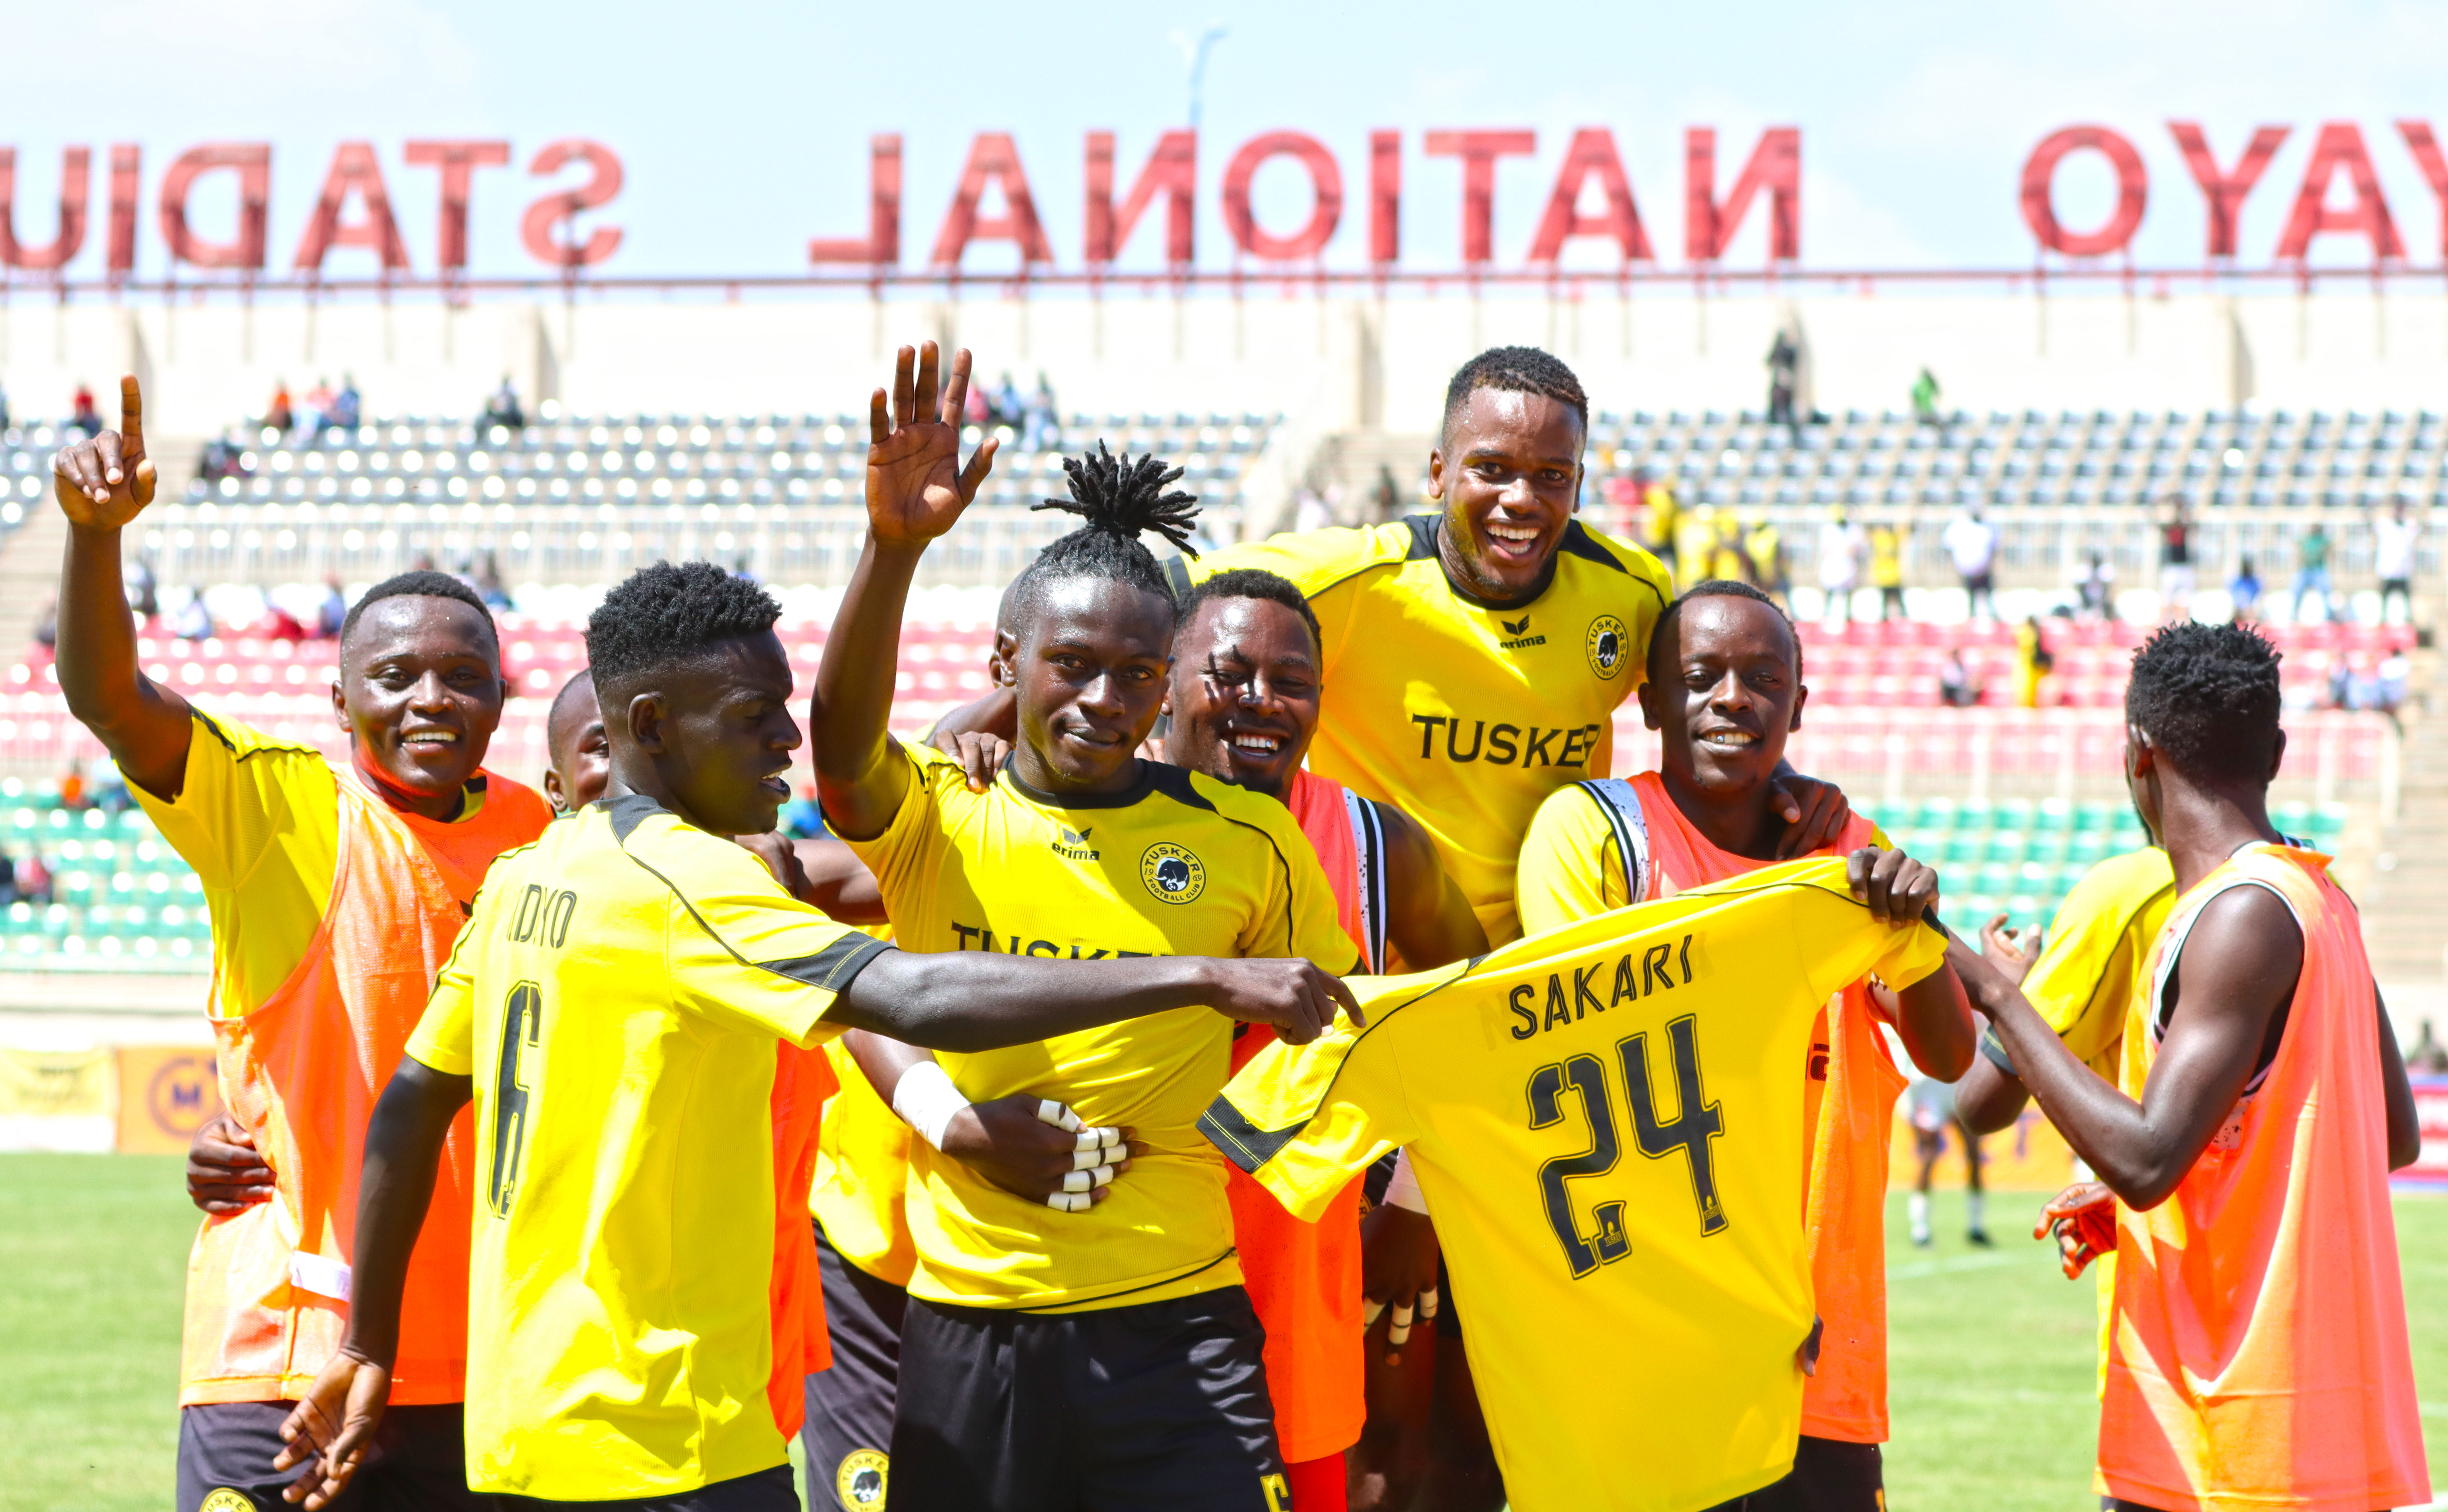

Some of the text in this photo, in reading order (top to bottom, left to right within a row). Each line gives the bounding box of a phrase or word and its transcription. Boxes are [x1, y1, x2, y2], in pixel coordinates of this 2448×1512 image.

[1500, 635, 1546, 649] erima
[1589, 620, 1625, 647] TUSKER
[1592, 653, 1625, 676] FOOTBALL CLUB
[1051, 842, 1100, 861] erima
[1144, 847, 1200, 872] TUSKER
[1148, 879, 1200, 901] FOOTBALL CLUB
[1509, 934, 1693, 1040] SAKARI
[487, 980, 542, 1220] 6
[1525, 1013, 1729, 1280] 24
[1604, 1233, 1622, 1245] TUSKER
